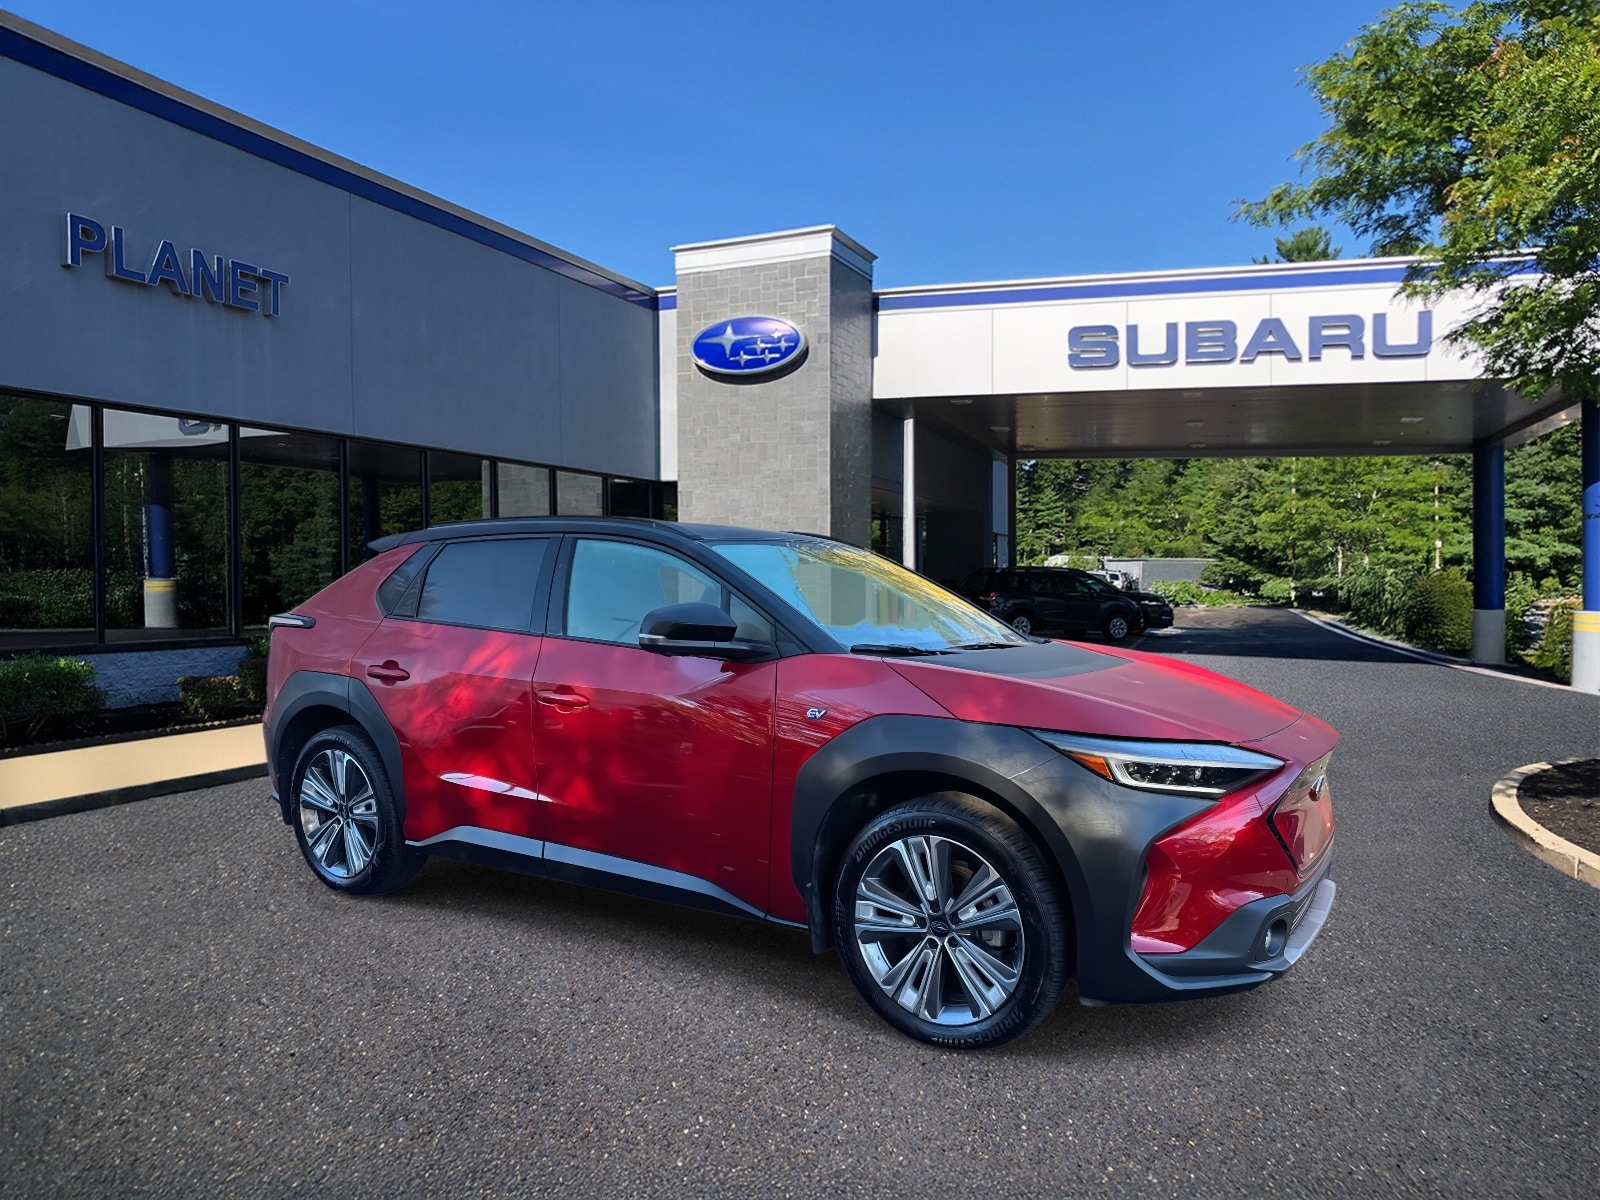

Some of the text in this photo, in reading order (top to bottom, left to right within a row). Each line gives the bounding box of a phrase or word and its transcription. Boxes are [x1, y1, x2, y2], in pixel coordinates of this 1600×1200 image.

[65, 212, 290, 317] PLANET
[1067, 309, 1433, 369] SUBARU
[806, 707, 827, 719] EV
